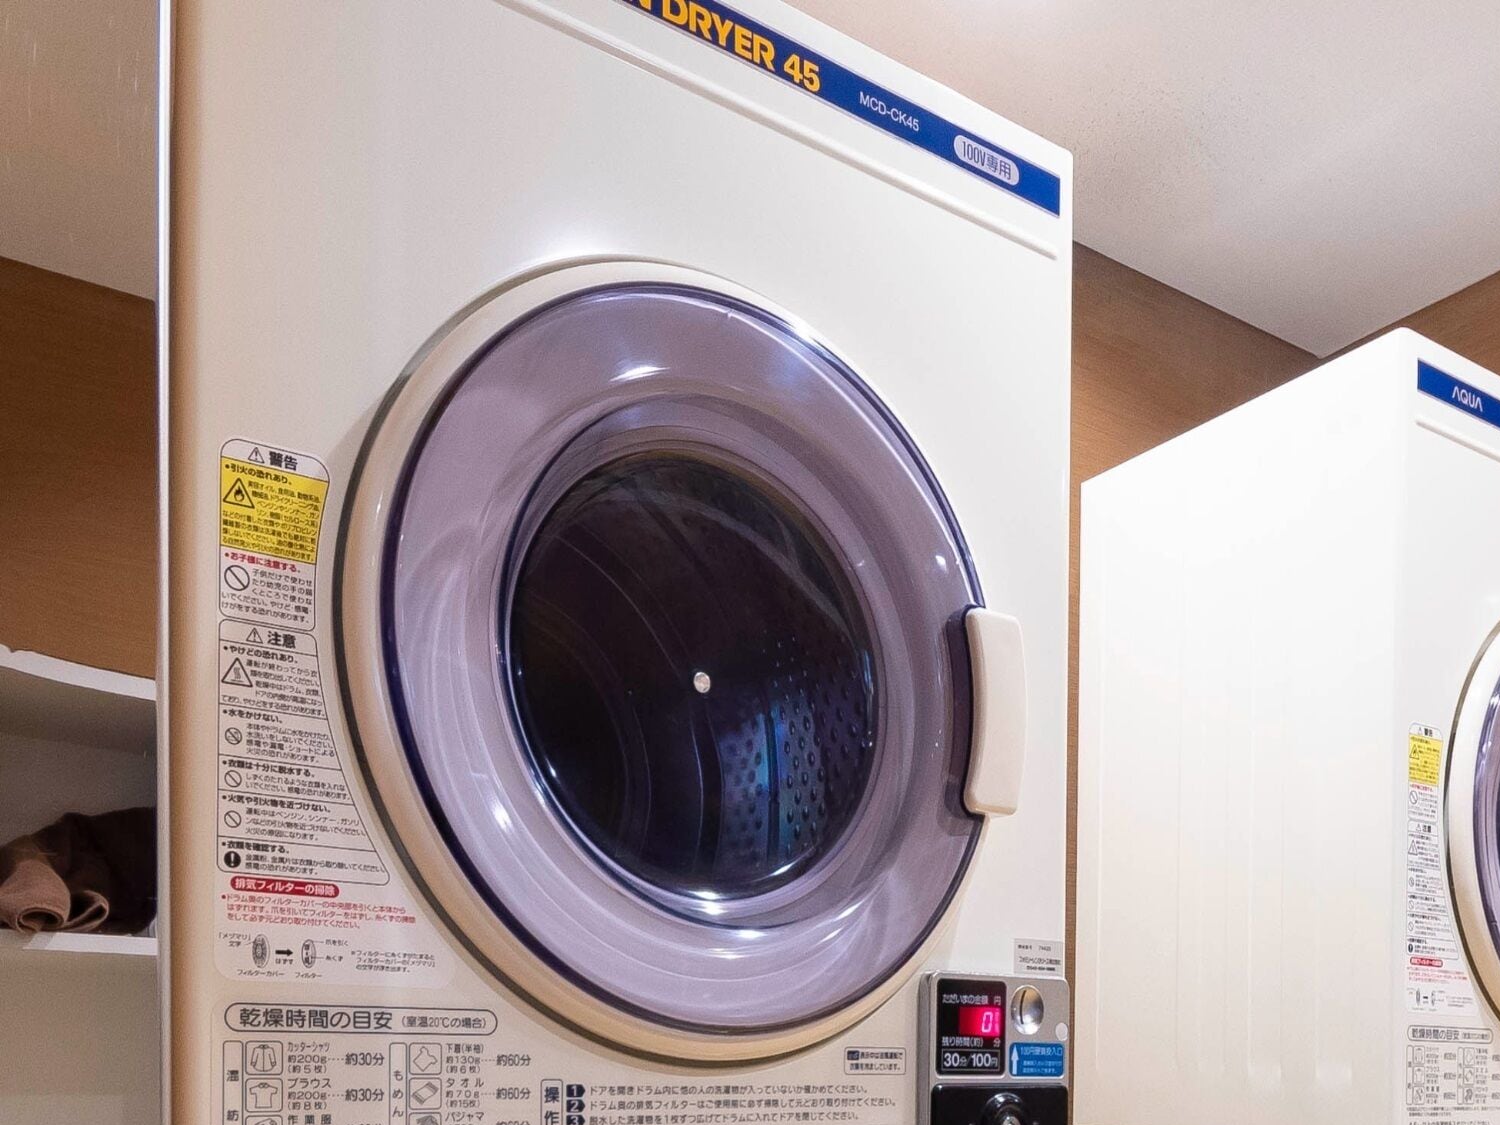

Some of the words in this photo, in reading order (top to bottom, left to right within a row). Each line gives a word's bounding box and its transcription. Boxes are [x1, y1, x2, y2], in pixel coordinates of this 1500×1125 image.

[662, 0, 775, 70] DRYER
[783, 53, 821, 92] 45
[859, 91, 919, 132] MCD-CK45
[961, 140, 1012, 181] 100V専用
[1452, 386, 1483, 412] AQUA
[269, 451, 298, 471] 警告
[267, 630, 296, 649] 注意
[235, 878, 335, 897] 排気フィルターの掃除
[239, 1008, 393, 1031] 乾燥時間の目安
[345, 1053, 385, 1066] 約30分
[496, 1054, 531, 1067] 約60分
[943, 1053, 999, 1067] 30分/100円
[287, 1078, 332, 1089] ブラウス
[345, 1089, 385, 1101] 約30分
[392, 1070, 404, 1118] もめん
[496, 1088, 531, 1100] 約60分
[569, 1100, 579, 1112] 2
[445, 1112, 485, 1122] パジャマ
